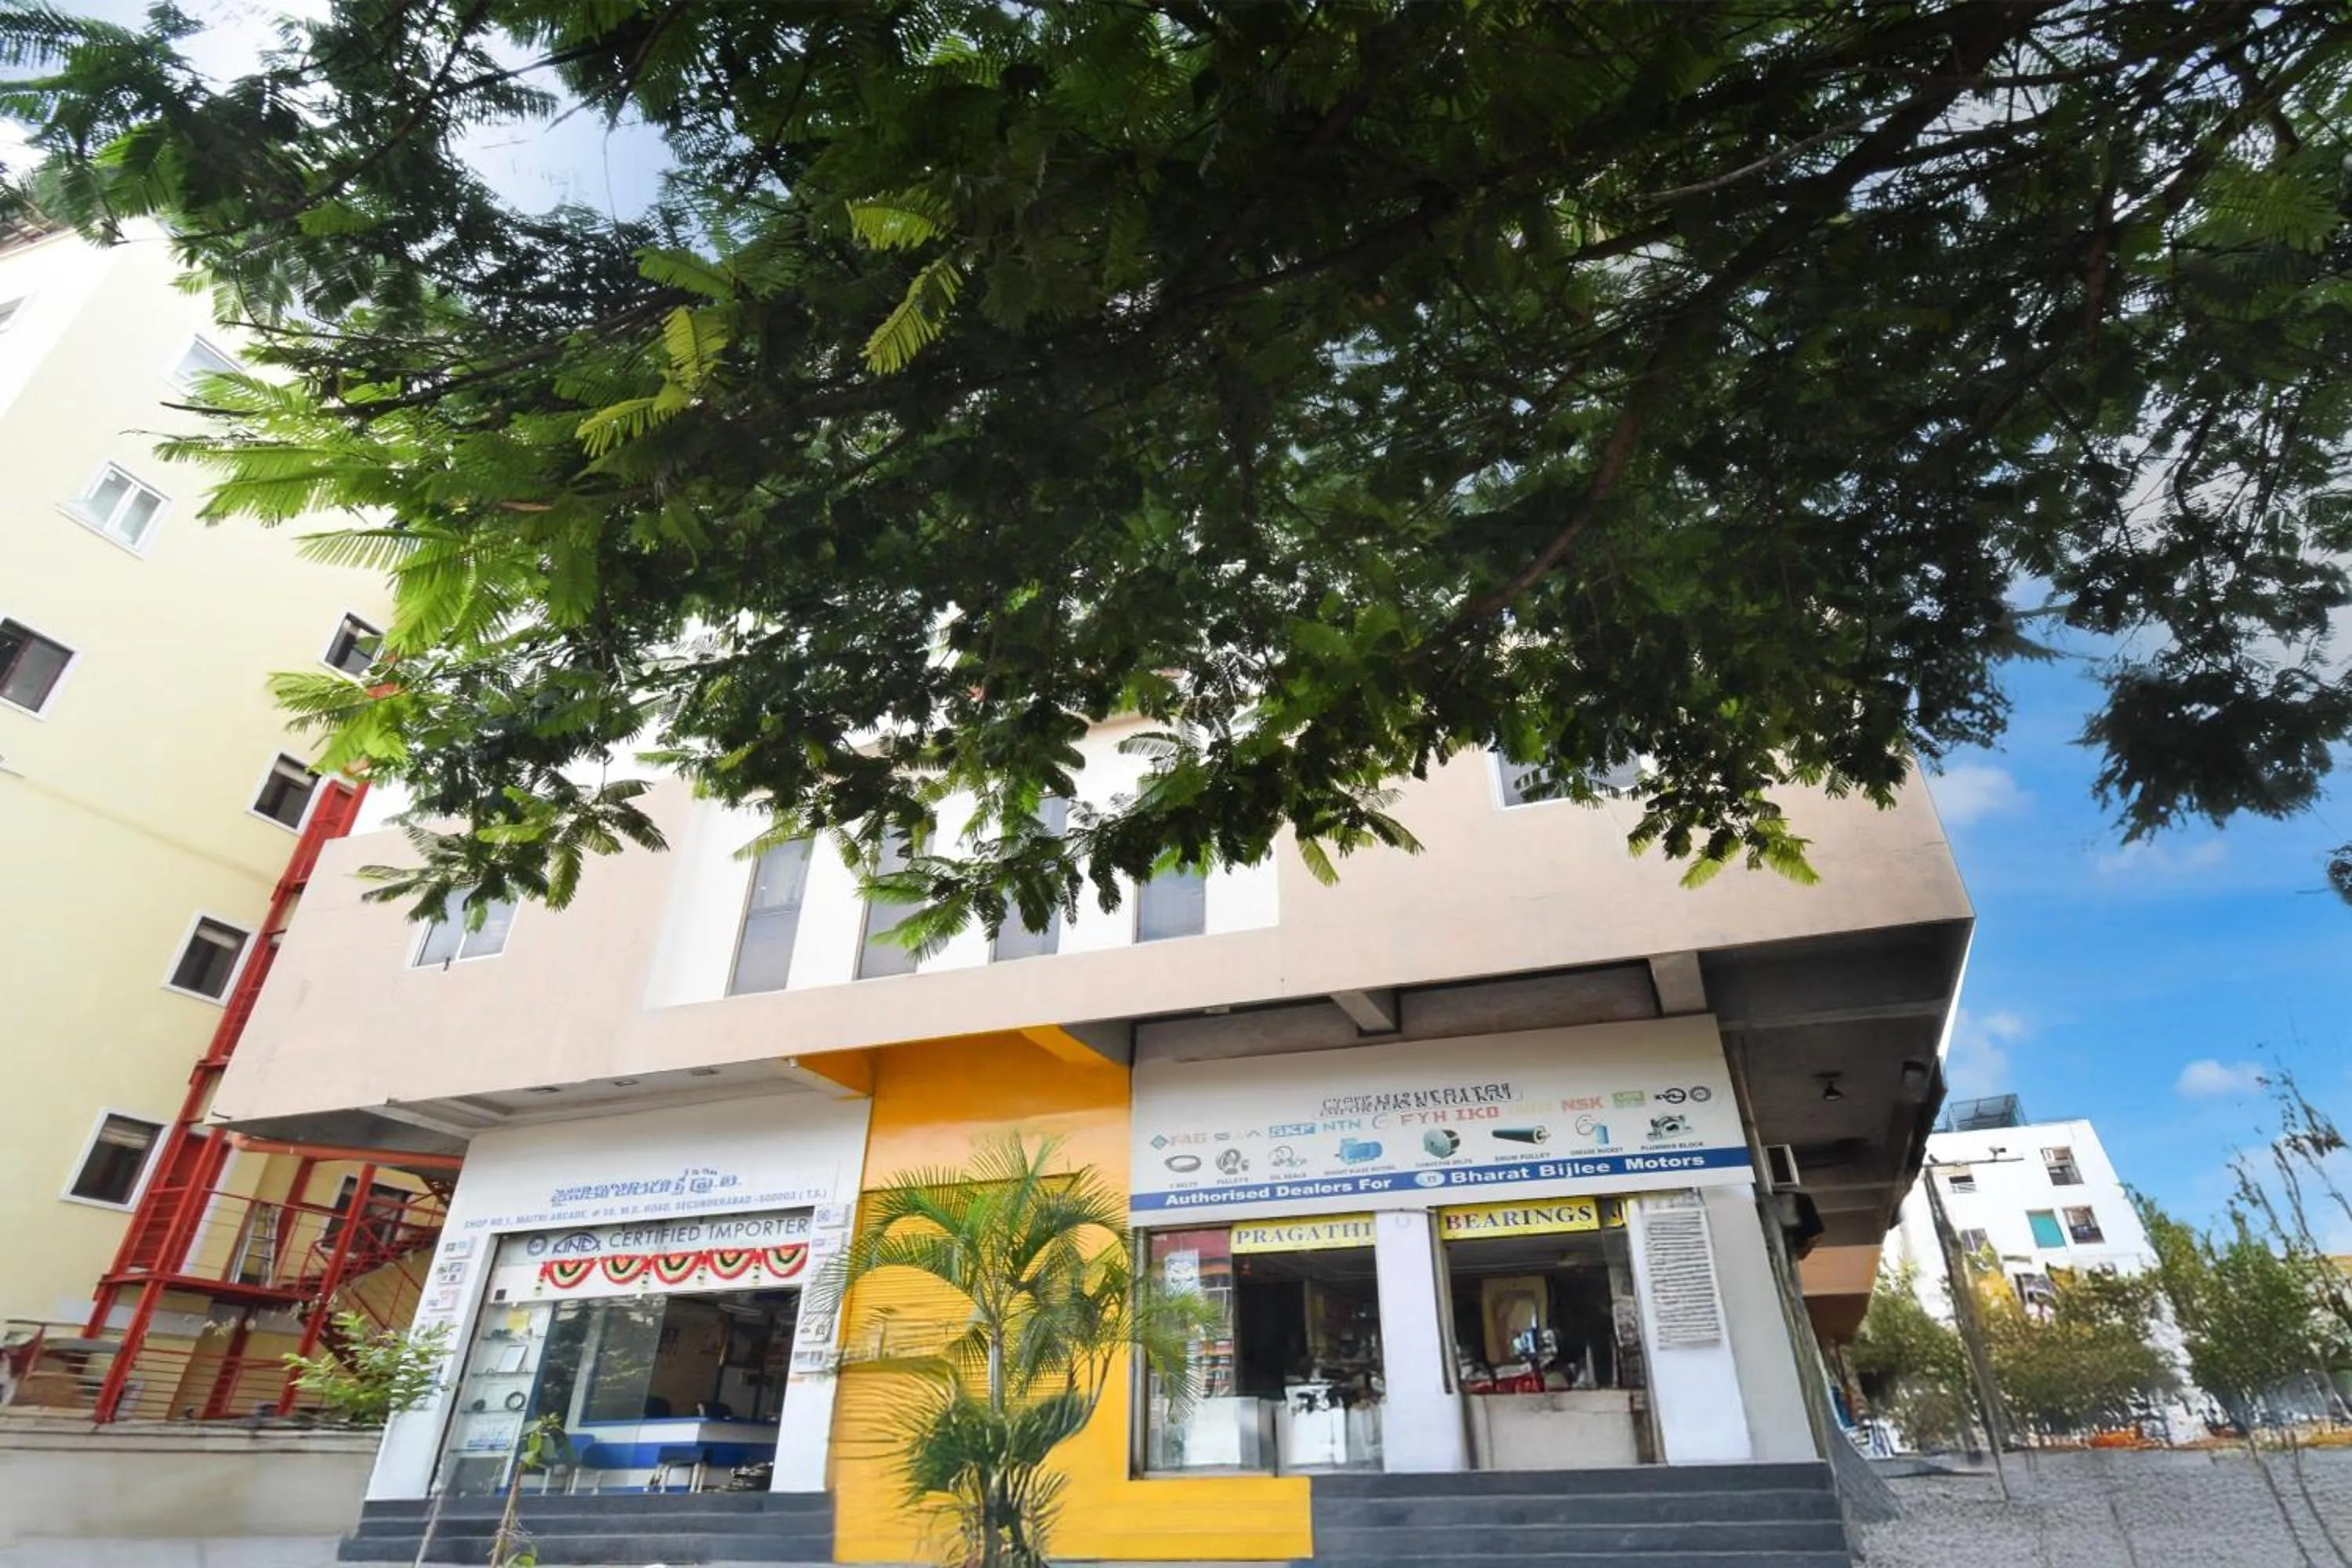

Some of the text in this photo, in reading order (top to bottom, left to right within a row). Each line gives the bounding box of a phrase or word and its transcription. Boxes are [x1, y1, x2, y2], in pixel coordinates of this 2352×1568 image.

[1322, 1119, 1361, 1131] NTN
[1399, 1109, 1447, 1126] FYH
[1561, 1096, 1605, 1112] NSK
[1165, 1186, 1269, 1207] Authorised
[1276, 1178, 1353, 1197] Dealers
[1358, 1177, 1392, 1192] For
[1451, 1165, 1530, 1184] Bharat
[1539, 1161, 1611, 1178] Bijlee
[1624, 1154, 1705, 1171] Motors
[1446, 1205, 1592, 1230] BEARINGS
[609, 1225, 700, 1248] CERTIFIED
[709, 1218, 808, 1240] IMPORTER
[1236, 1221, 1372, 1245] PRAGATHI
